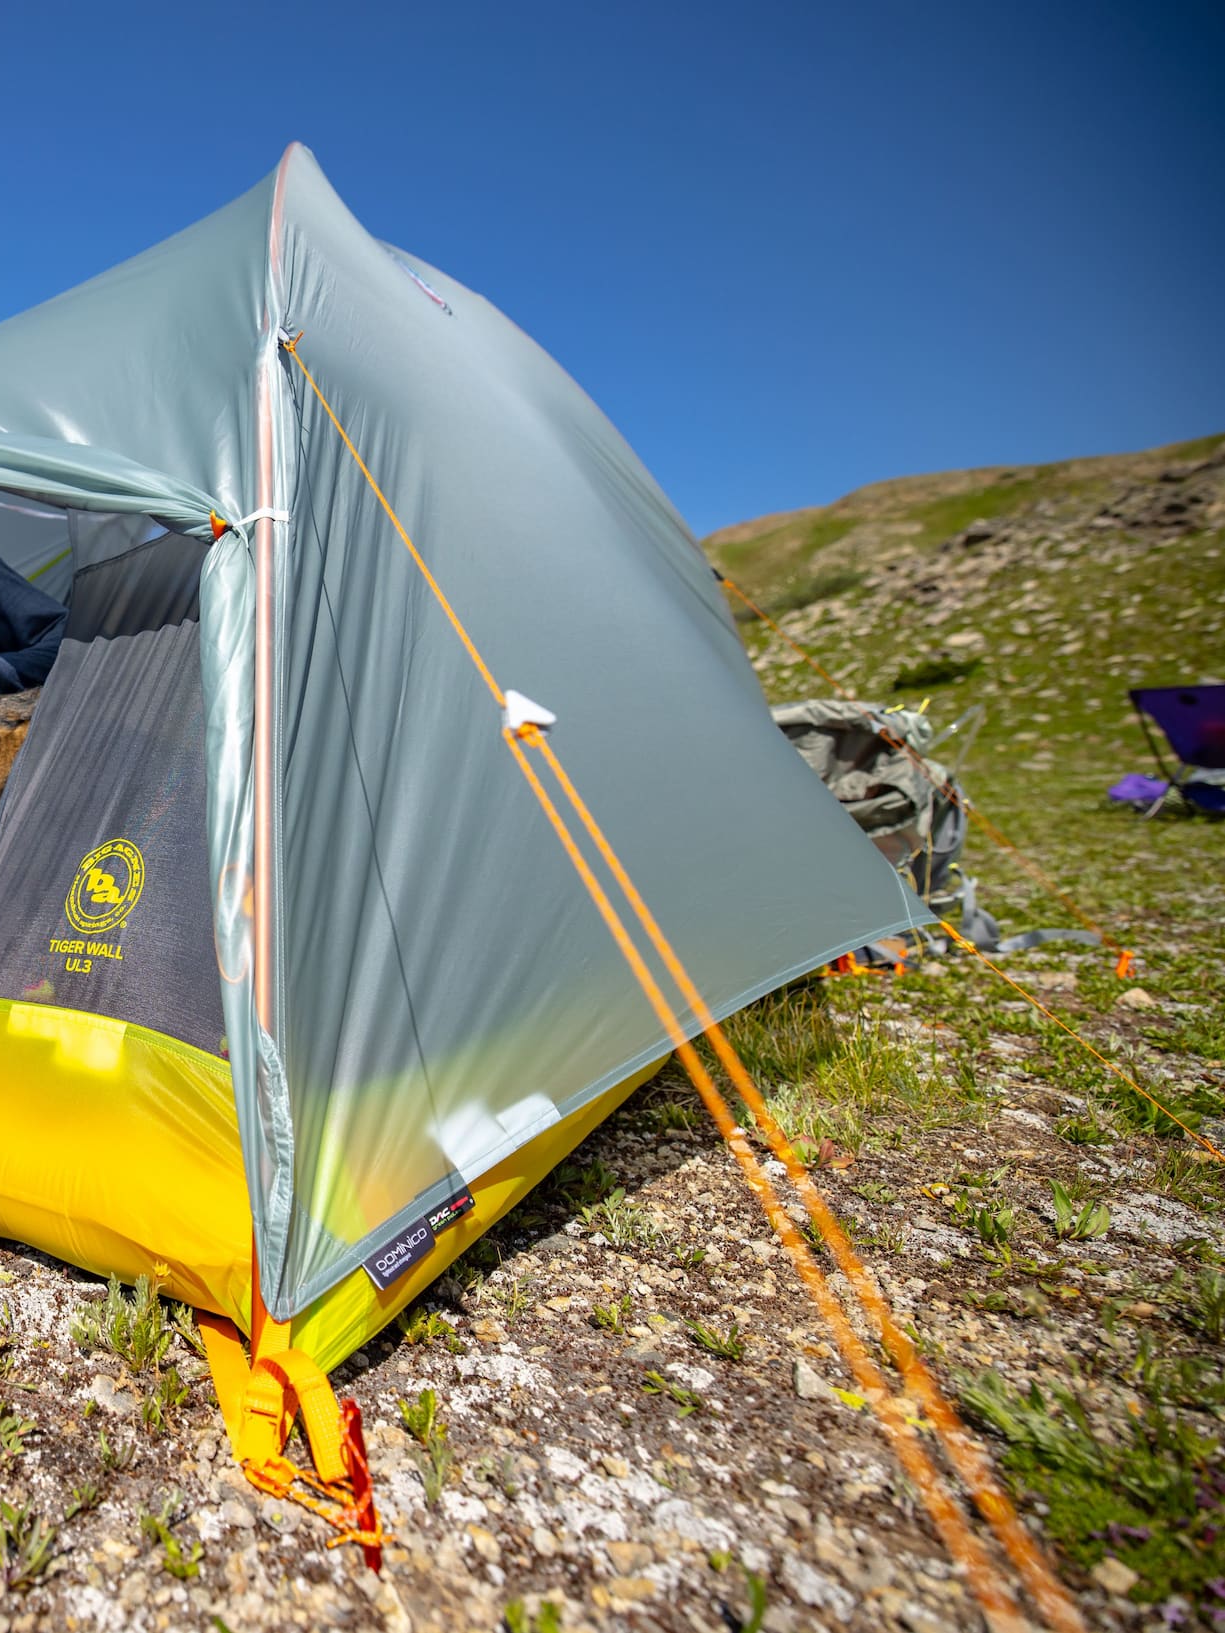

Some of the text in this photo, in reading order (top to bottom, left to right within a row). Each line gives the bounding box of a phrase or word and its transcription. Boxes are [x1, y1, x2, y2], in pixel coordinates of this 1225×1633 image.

[81, 845, 113, 872] BIG
[49, 939, 123, 960] TIGER WALL
[65, 957, 93, 973] UL3
[428, 1207, 451, 1226] DAC
